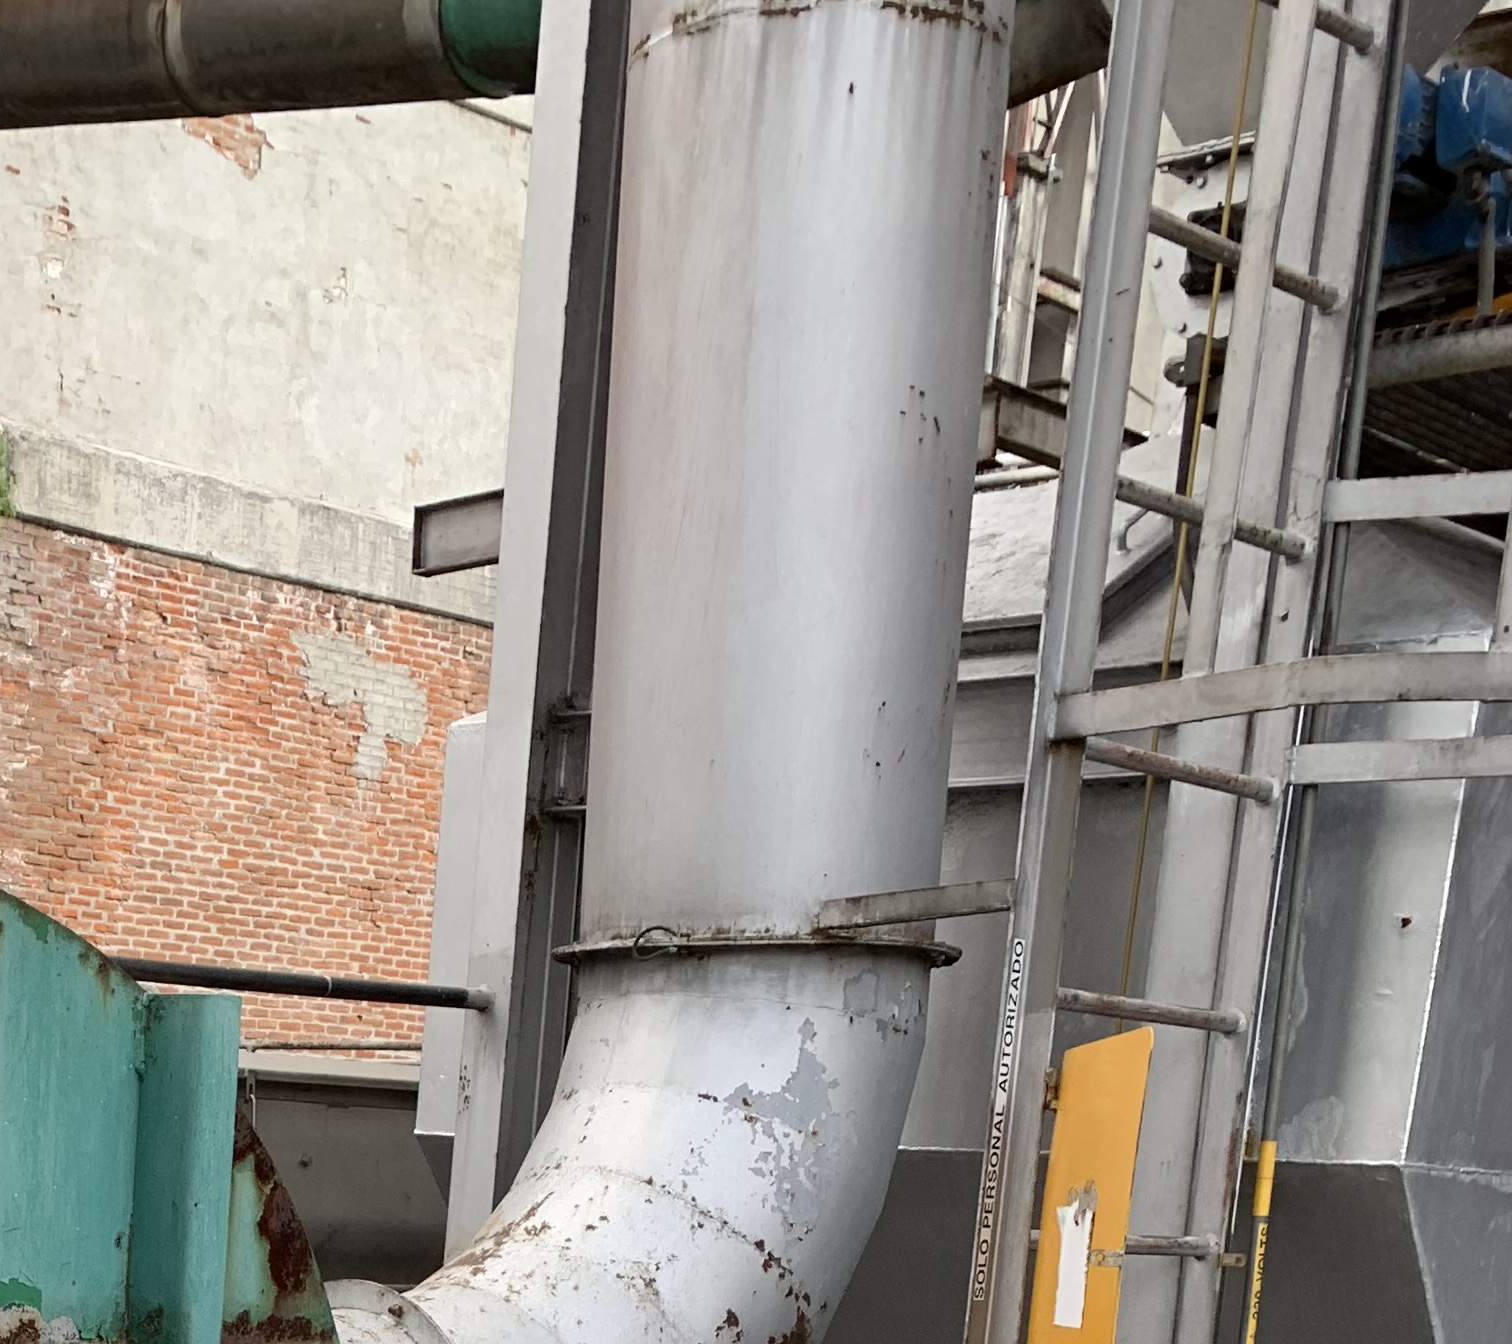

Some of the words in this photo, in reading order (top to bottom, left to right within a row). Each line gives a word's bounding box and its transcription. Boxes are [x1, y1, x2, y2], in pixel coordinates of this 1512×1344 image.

[974, 1239, 990, 1299] SOLO
[982, 1105, 1005, 1229] PERSONAL
[998, 940, 1024, 1093] AUTORIZADO
